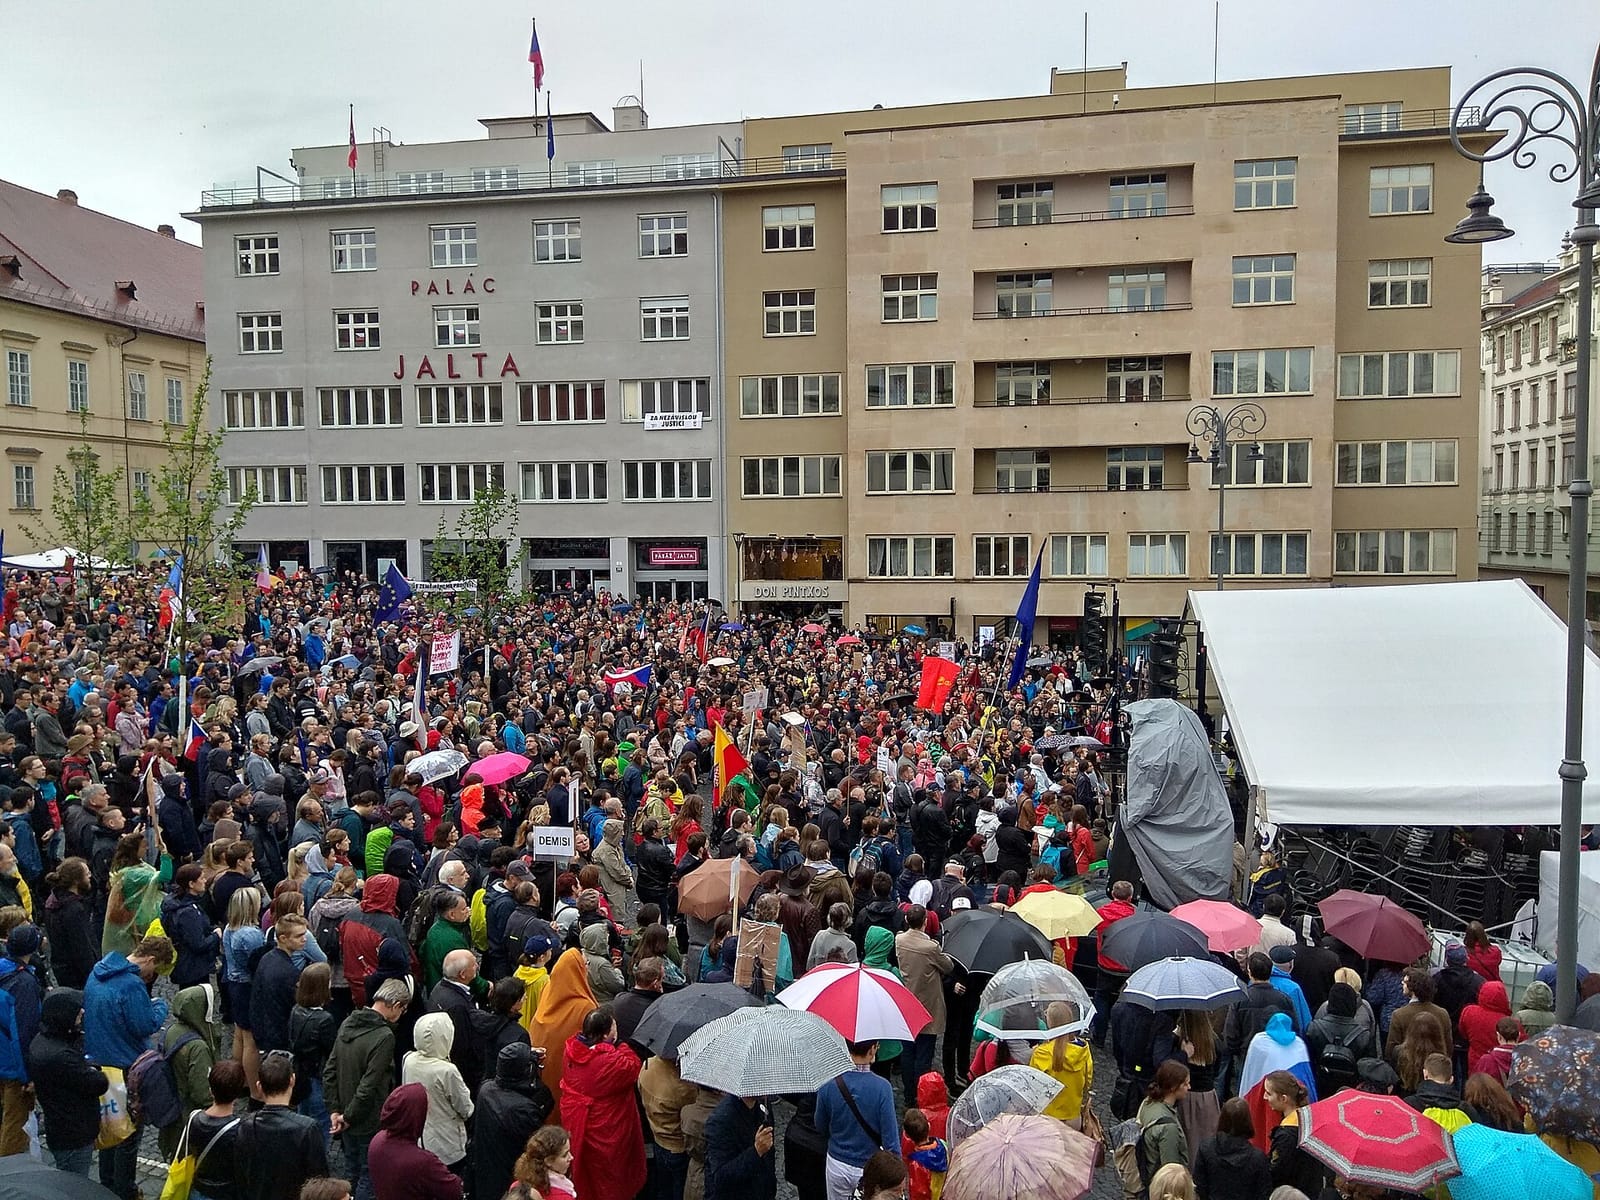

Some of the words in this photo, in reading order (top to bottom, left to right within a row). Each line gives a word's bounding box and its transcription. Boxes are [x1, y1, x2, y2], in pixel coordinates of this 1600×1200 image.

[411, 272, 495, 296] PALÁC
[393, 352, 520, 380] JALTA
[676, 552, 694, 560] JALTA
[755, 586, 777, 598] DON
[782, 585, 829, 598] PINTXOS
[539, 836, 571, 847] DEMISI
